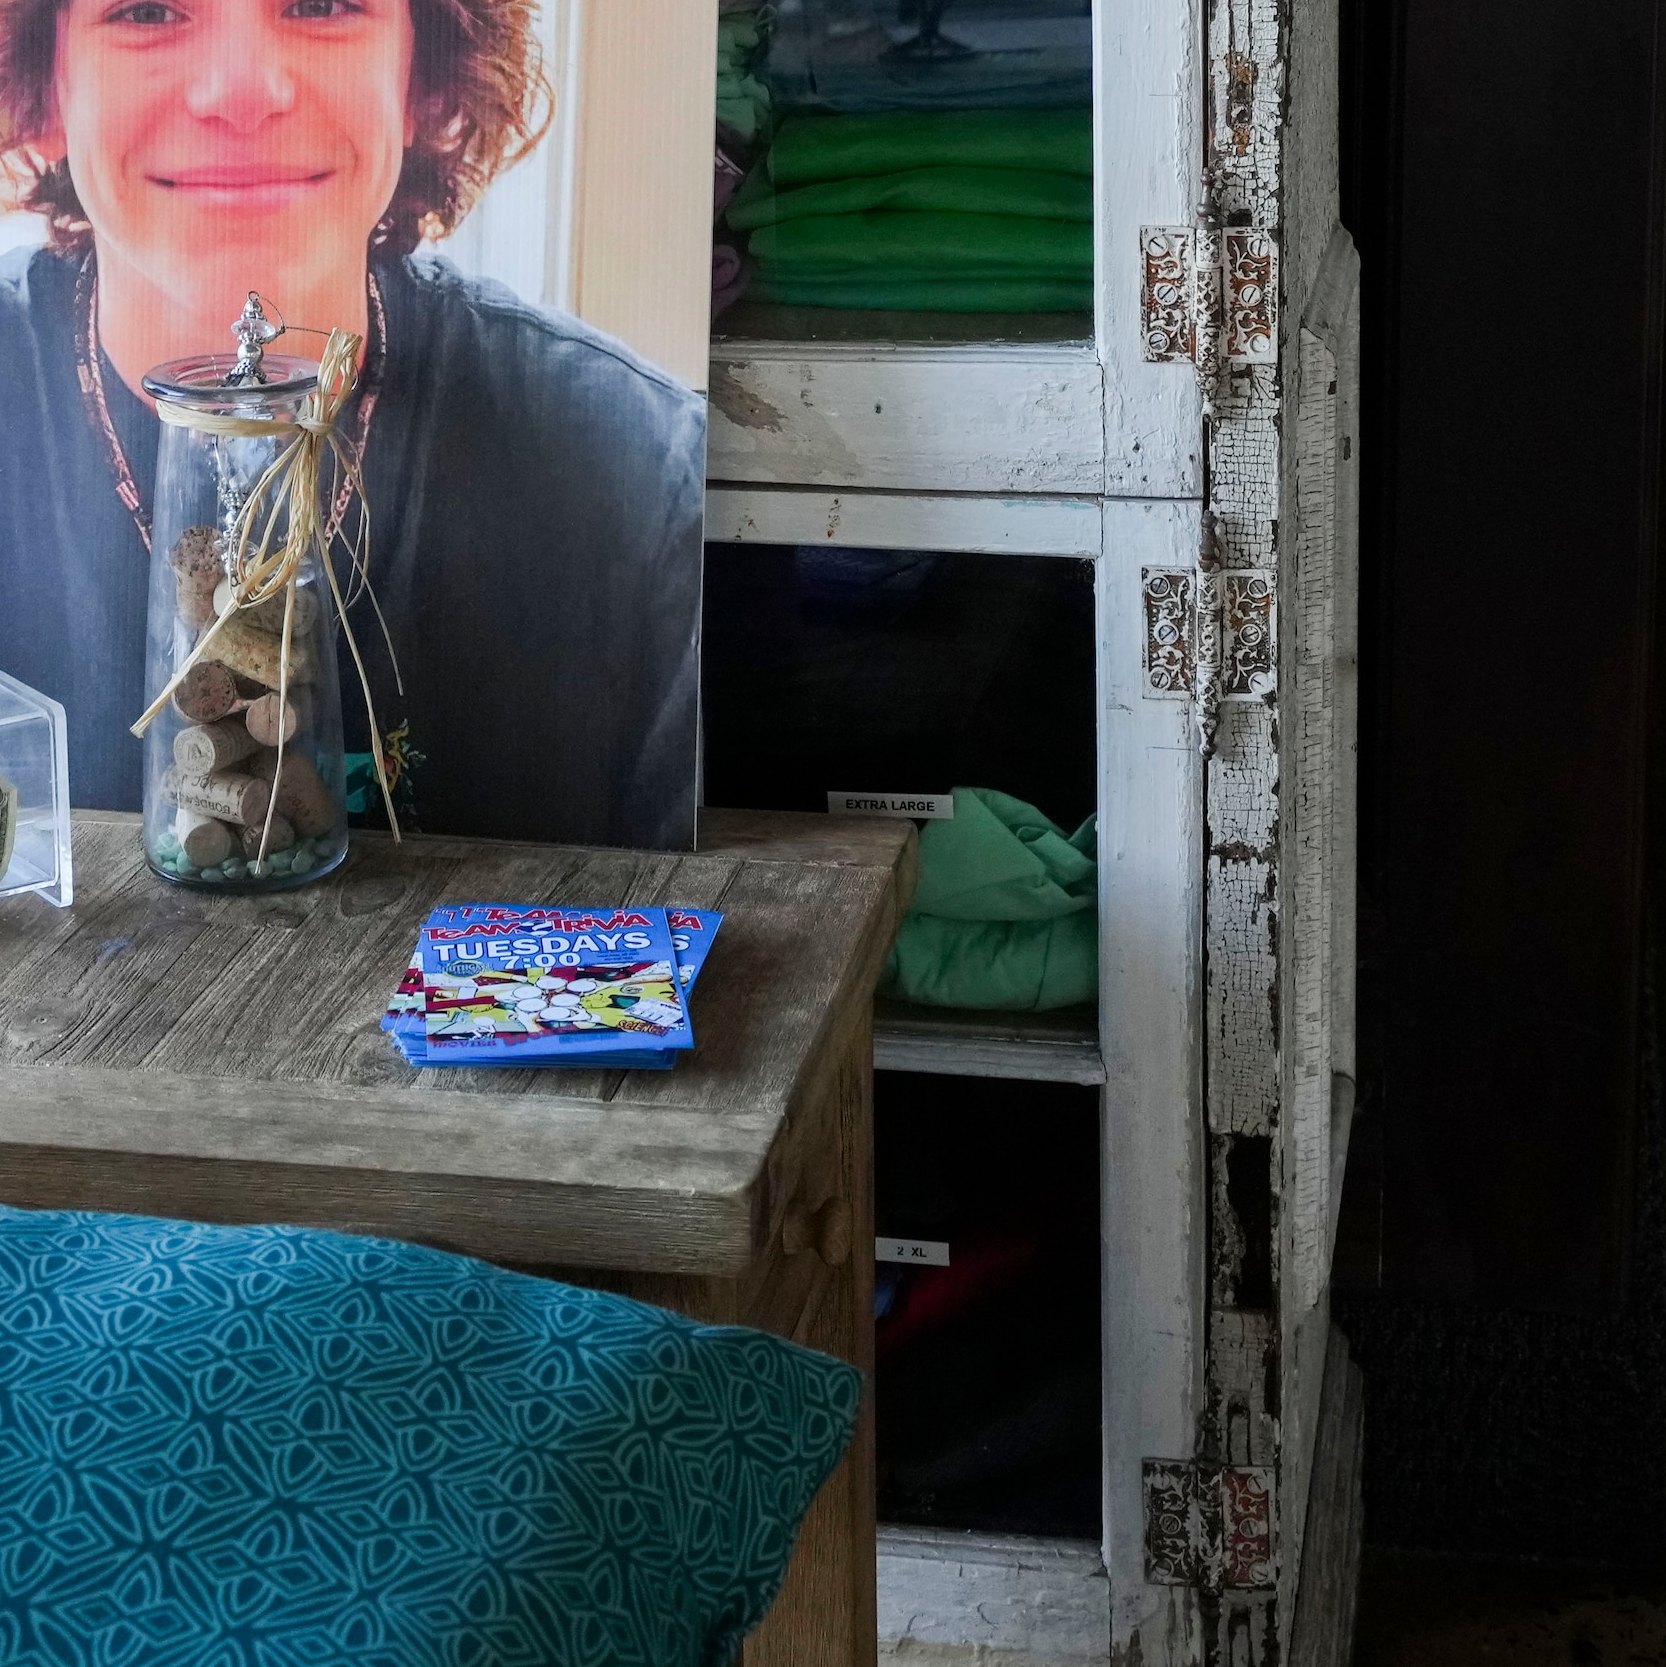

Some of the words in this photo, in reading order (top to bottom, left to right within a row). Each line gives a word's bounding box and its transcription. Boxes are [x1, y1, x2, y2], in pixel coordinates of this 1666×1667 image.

[845, 799, 888, 810] EXTRA
[891, 800, 935, 812] LARGE
[433, 931, 651, 962] TUESDAYS
[499, 951, 582, 970] 7:00
[897, 1246, 904, 1256] 2
[911, 1247, 927, 1258] XL
